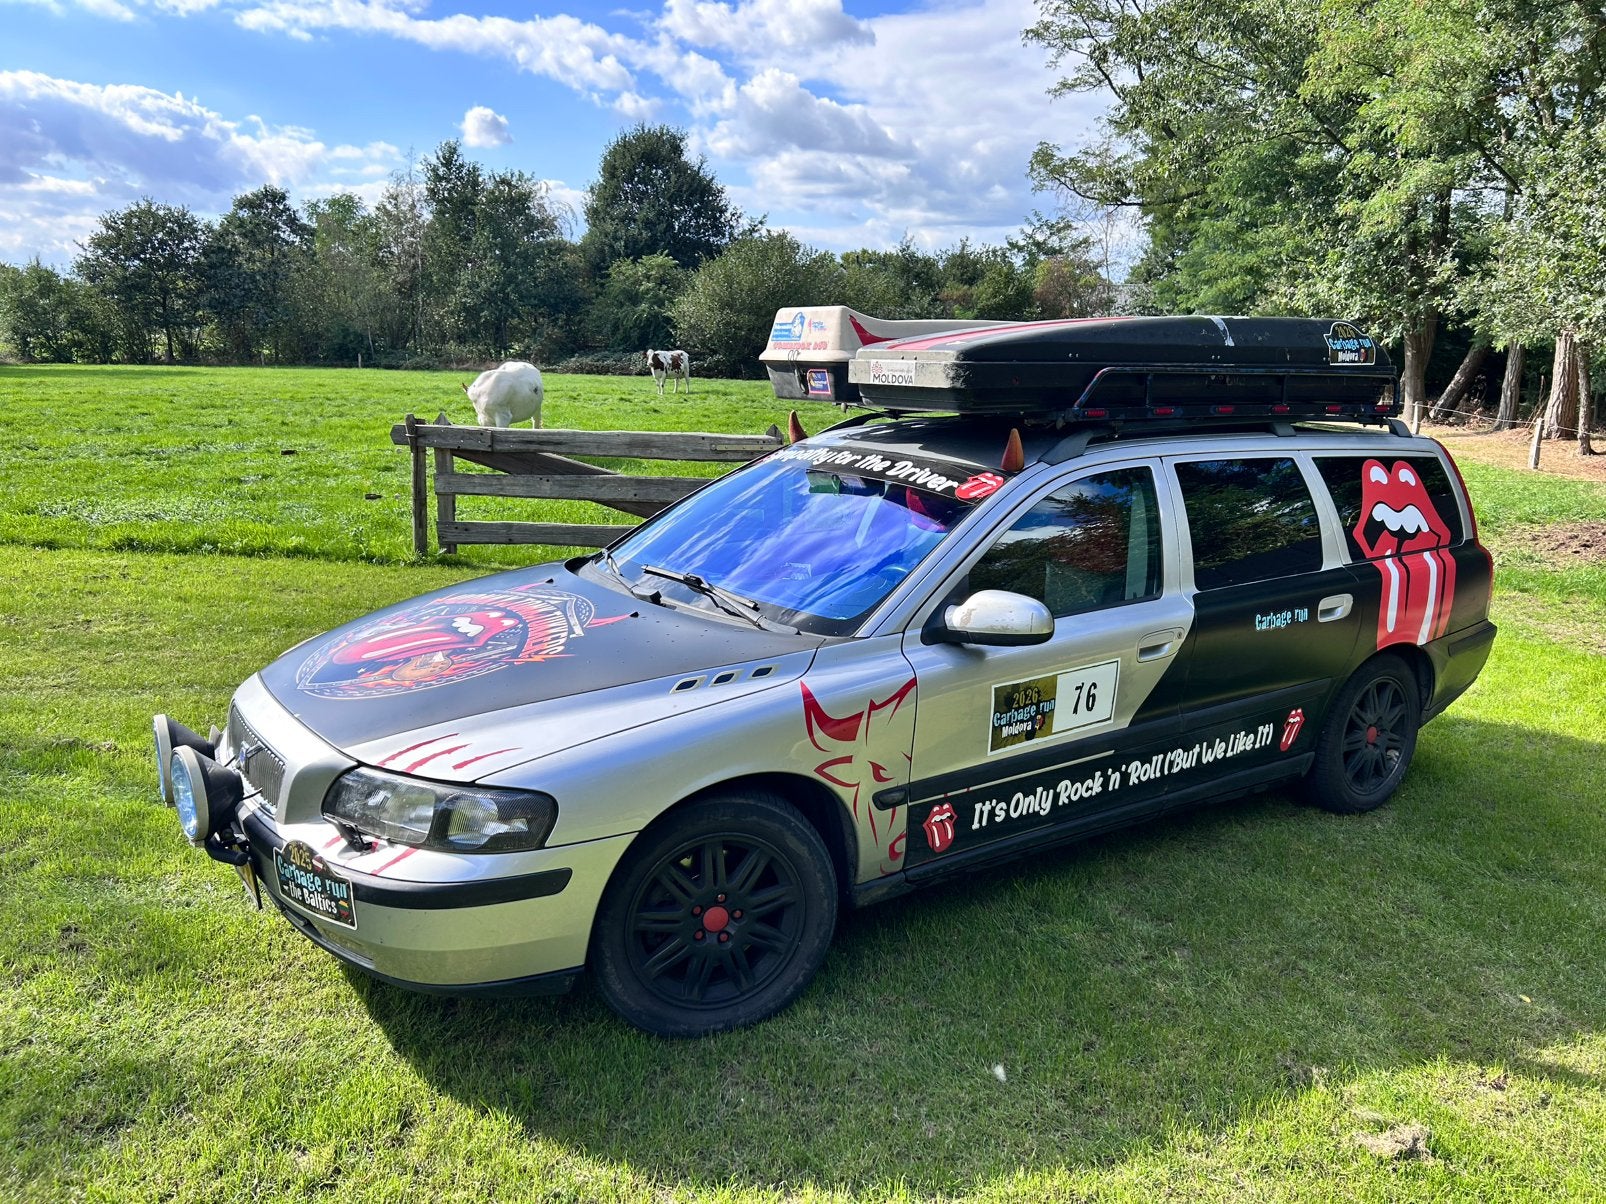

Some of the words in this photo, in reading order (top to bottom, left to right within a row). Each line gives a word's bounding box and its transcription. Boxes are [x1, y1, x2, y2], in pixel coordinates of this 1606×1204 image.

[872, 374, 914, 385] MOLDOVA
[826, 451, 862, 465] for
[854, 454, 892, 472] the
[885, 461, 959, 492] Driver
[1294, 608, 1308, 622] run
[1012, 688, 1039, 708] 2026
[1072, 682, 1098, 715] 76
[993, 704, 1037, 727] Carbage
[1039, 699, 1055, 712] run
[1001, 721, 1032, 738] Moldova
[971, 799, 1008, 830] It's
[1009, 786, 1054, 817] Only
[1056, 770, 1104, 806] Rock
[1127, 753, 1164, 786] Roll
[1164, 743, 1201, 775] (But
[1201, 737, 1226, 764] We
[1226, 730, 1254, 758] Like
[1254, 722, 1274, 749] It)
[289, 845, 313, 870] 2025
[277, 855, 322, 892] Carbage
[325, 879, 348, 899] run
[288, 880, 302, 900] the
[302, 887, 338, 914] Baltics
